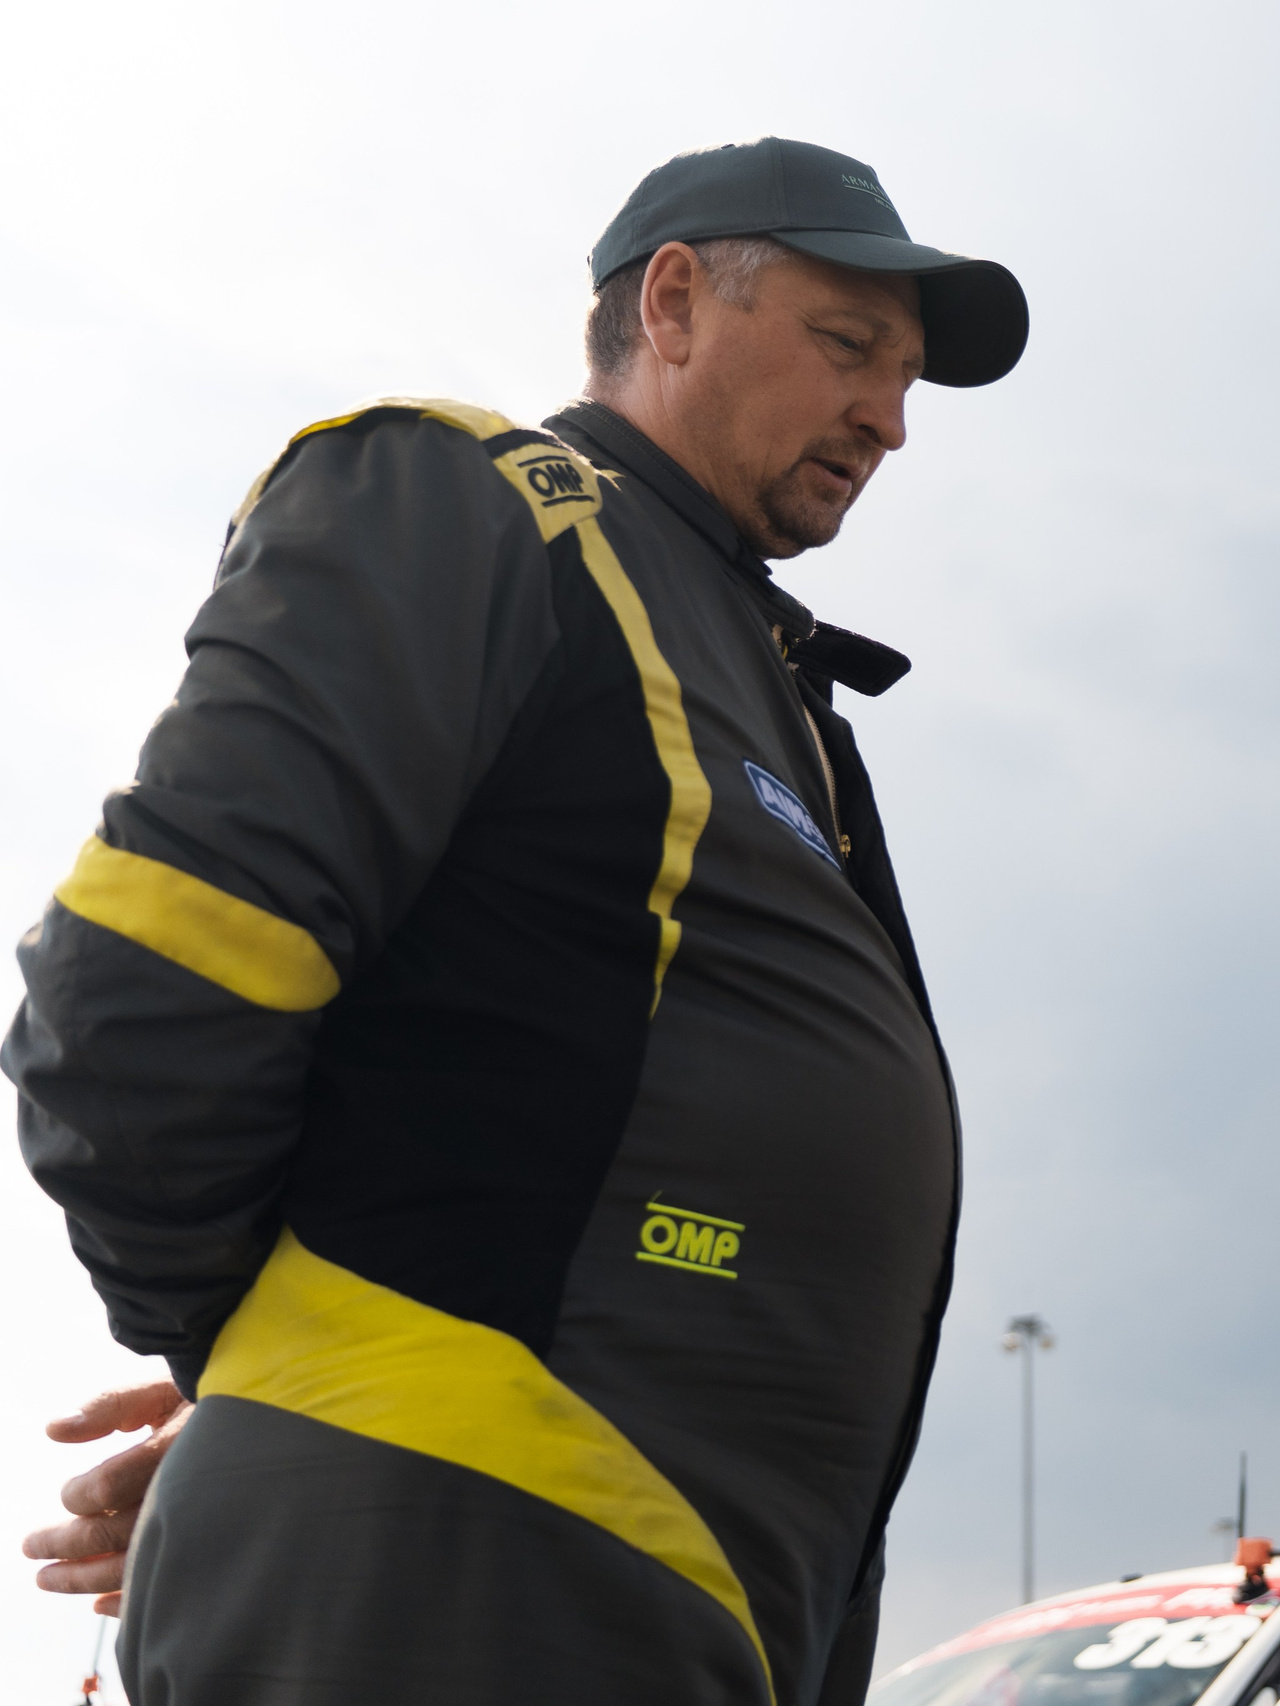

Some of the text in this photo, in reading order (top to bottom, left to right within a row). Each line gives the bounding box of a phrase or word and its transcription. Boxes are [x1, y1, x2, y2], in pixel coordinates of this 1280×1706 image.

[527, 462, 584, 498] OMP
[758, 776, 827, 847] AIMO
[641, 1214, 740, 1267] OMP
[1073, 1614, 1263, 1670] 313
